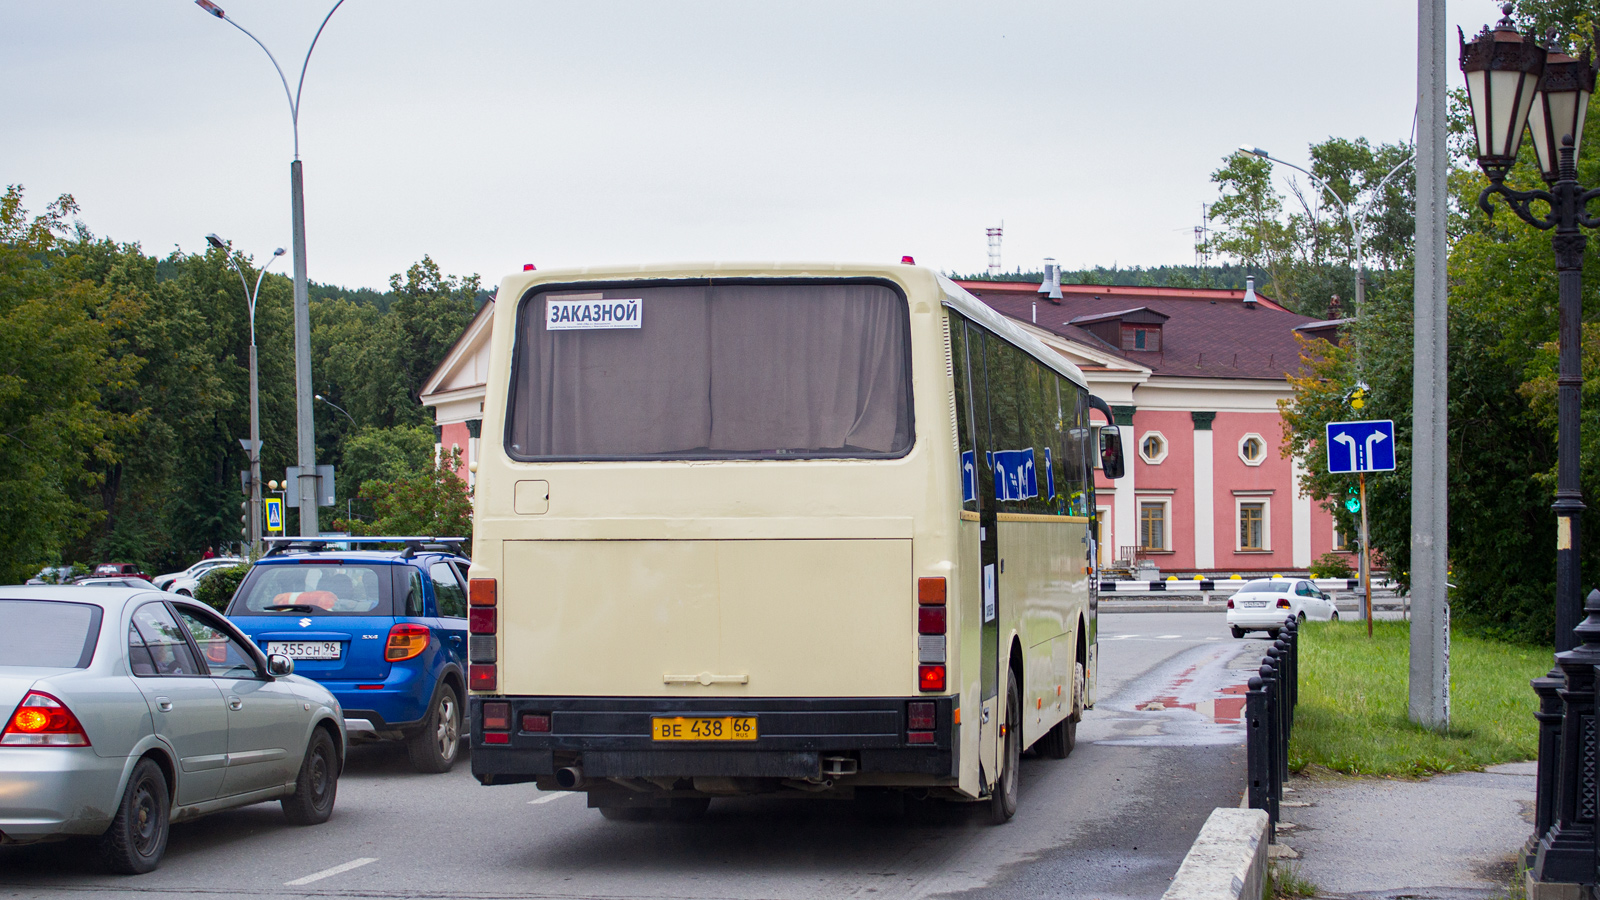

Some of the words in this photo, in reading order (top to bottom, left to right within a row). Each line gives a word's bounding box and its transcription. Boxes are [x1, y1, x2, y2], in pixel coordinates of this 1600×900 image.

[551, 300, 638, 323] ЗАКАЗНОЙ
[323, 642, 337, 653] 96
[691, 720, 723, 737] 438
[733, 718, 751, 732] 66
